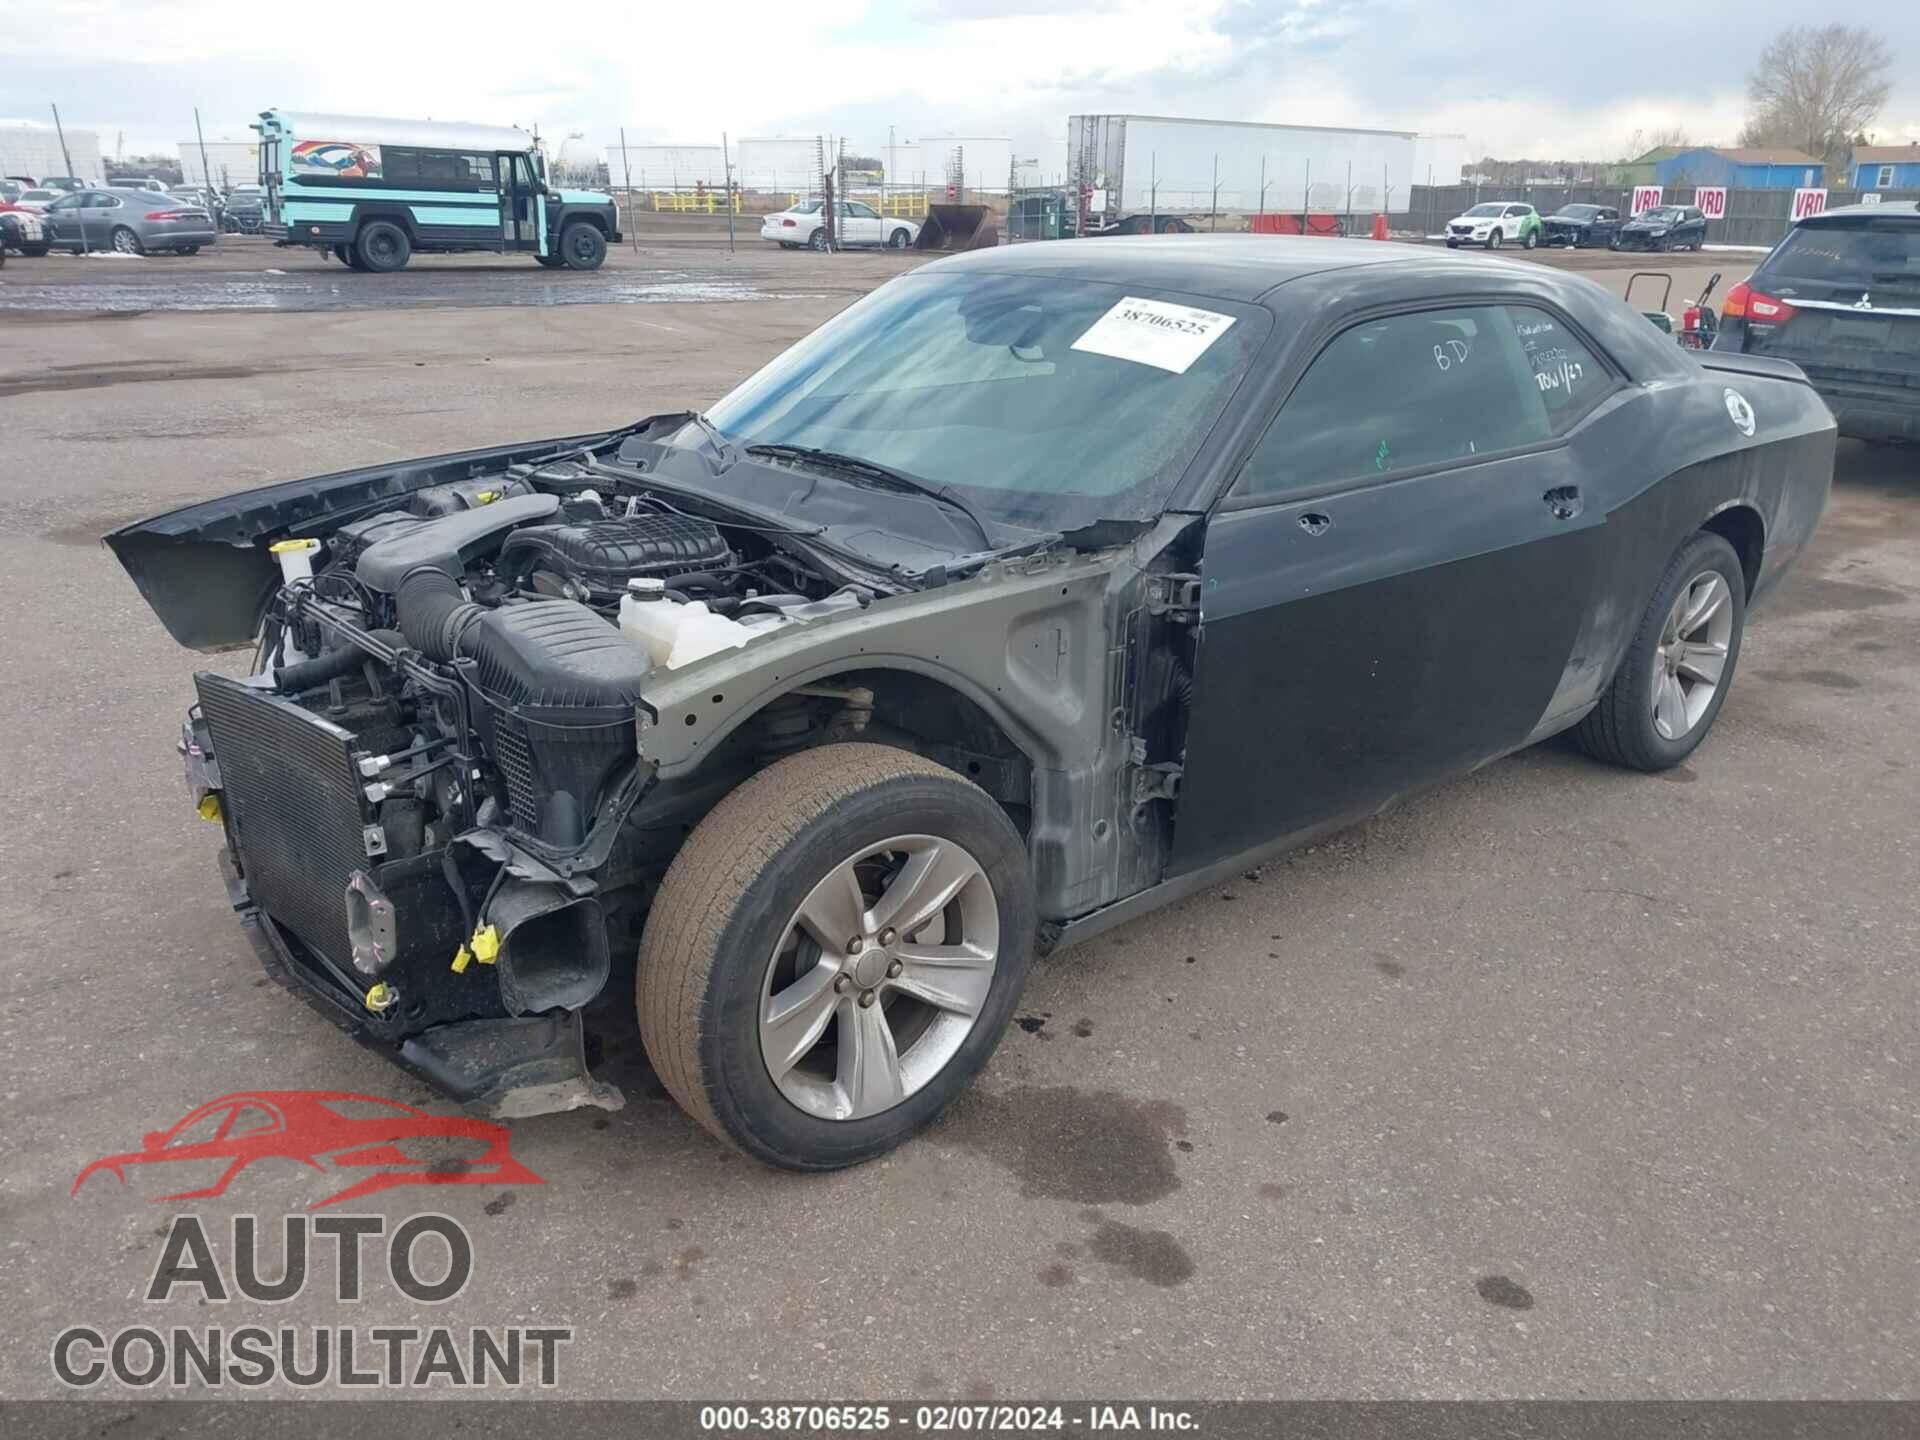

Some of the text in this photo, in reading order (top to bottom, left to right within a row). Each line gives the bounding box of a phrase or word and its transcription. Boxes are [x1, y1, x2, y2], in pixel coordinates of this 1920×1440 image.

[1635, 190, 1660, 213] VRD
[1698, 190, 1724, 214] VRD
[1796, 192, 1824, 217] VRD
[1117, 309, 1209, 335] 38706525
